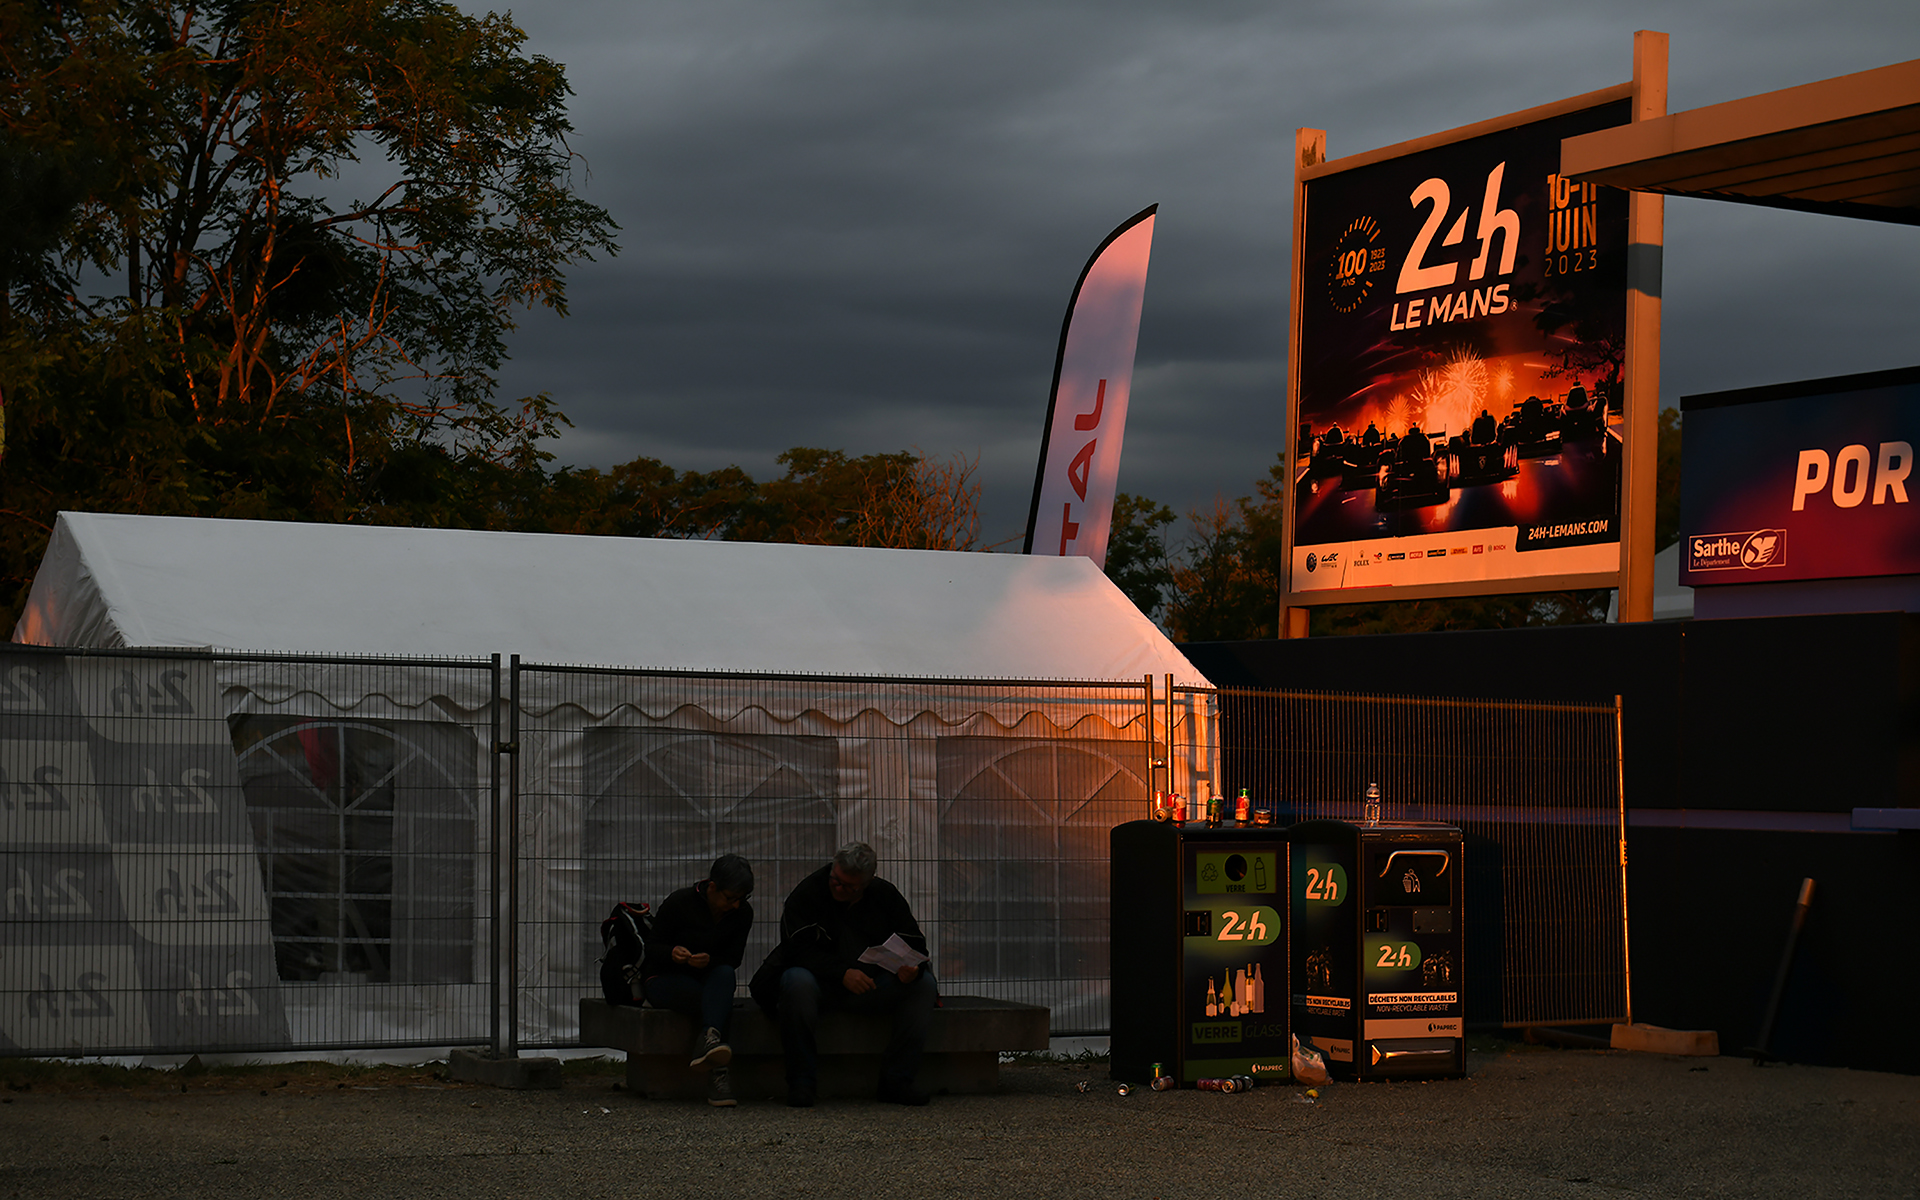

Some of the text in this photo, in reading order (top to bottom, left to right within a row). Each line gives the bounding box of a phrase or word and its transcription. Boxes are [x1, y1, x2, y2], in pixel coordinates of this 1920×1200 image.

[1395, 160, 1521, 295] 24h
[1545, 203, 1597, 256] JUIN
[1335, 248, 1368, 280] 100
[1370, 247, 1386, 260] 1923
[1544, 249, 1597, 278] 2023
[1369, 260, 1386, 273] 2023
[1340, 277, 1357, 288] ANS
[1389, 283, 1511, 332] LE MANS
[1791, 440, 1914, 512] POR
[1528, 519, 1609, 541] 24H-LEMANS.COM
[1693, 537, 1741, 558] Sarthe
[1226, 885, 1246, 893] VERRE
[1305, 867, 1338, 900] 24h
[1217, 910, 1267, 941] 24h
[1376, 944, 1412, 968] 24h
[1369, 993, 1456, 1003] DÉCHETS NON RECYCLABLES
[1376, 1004, 1449, 1013] NON-RECYCLABLE WASTE
[1194, 1026, 1238, 1039] VERRE
